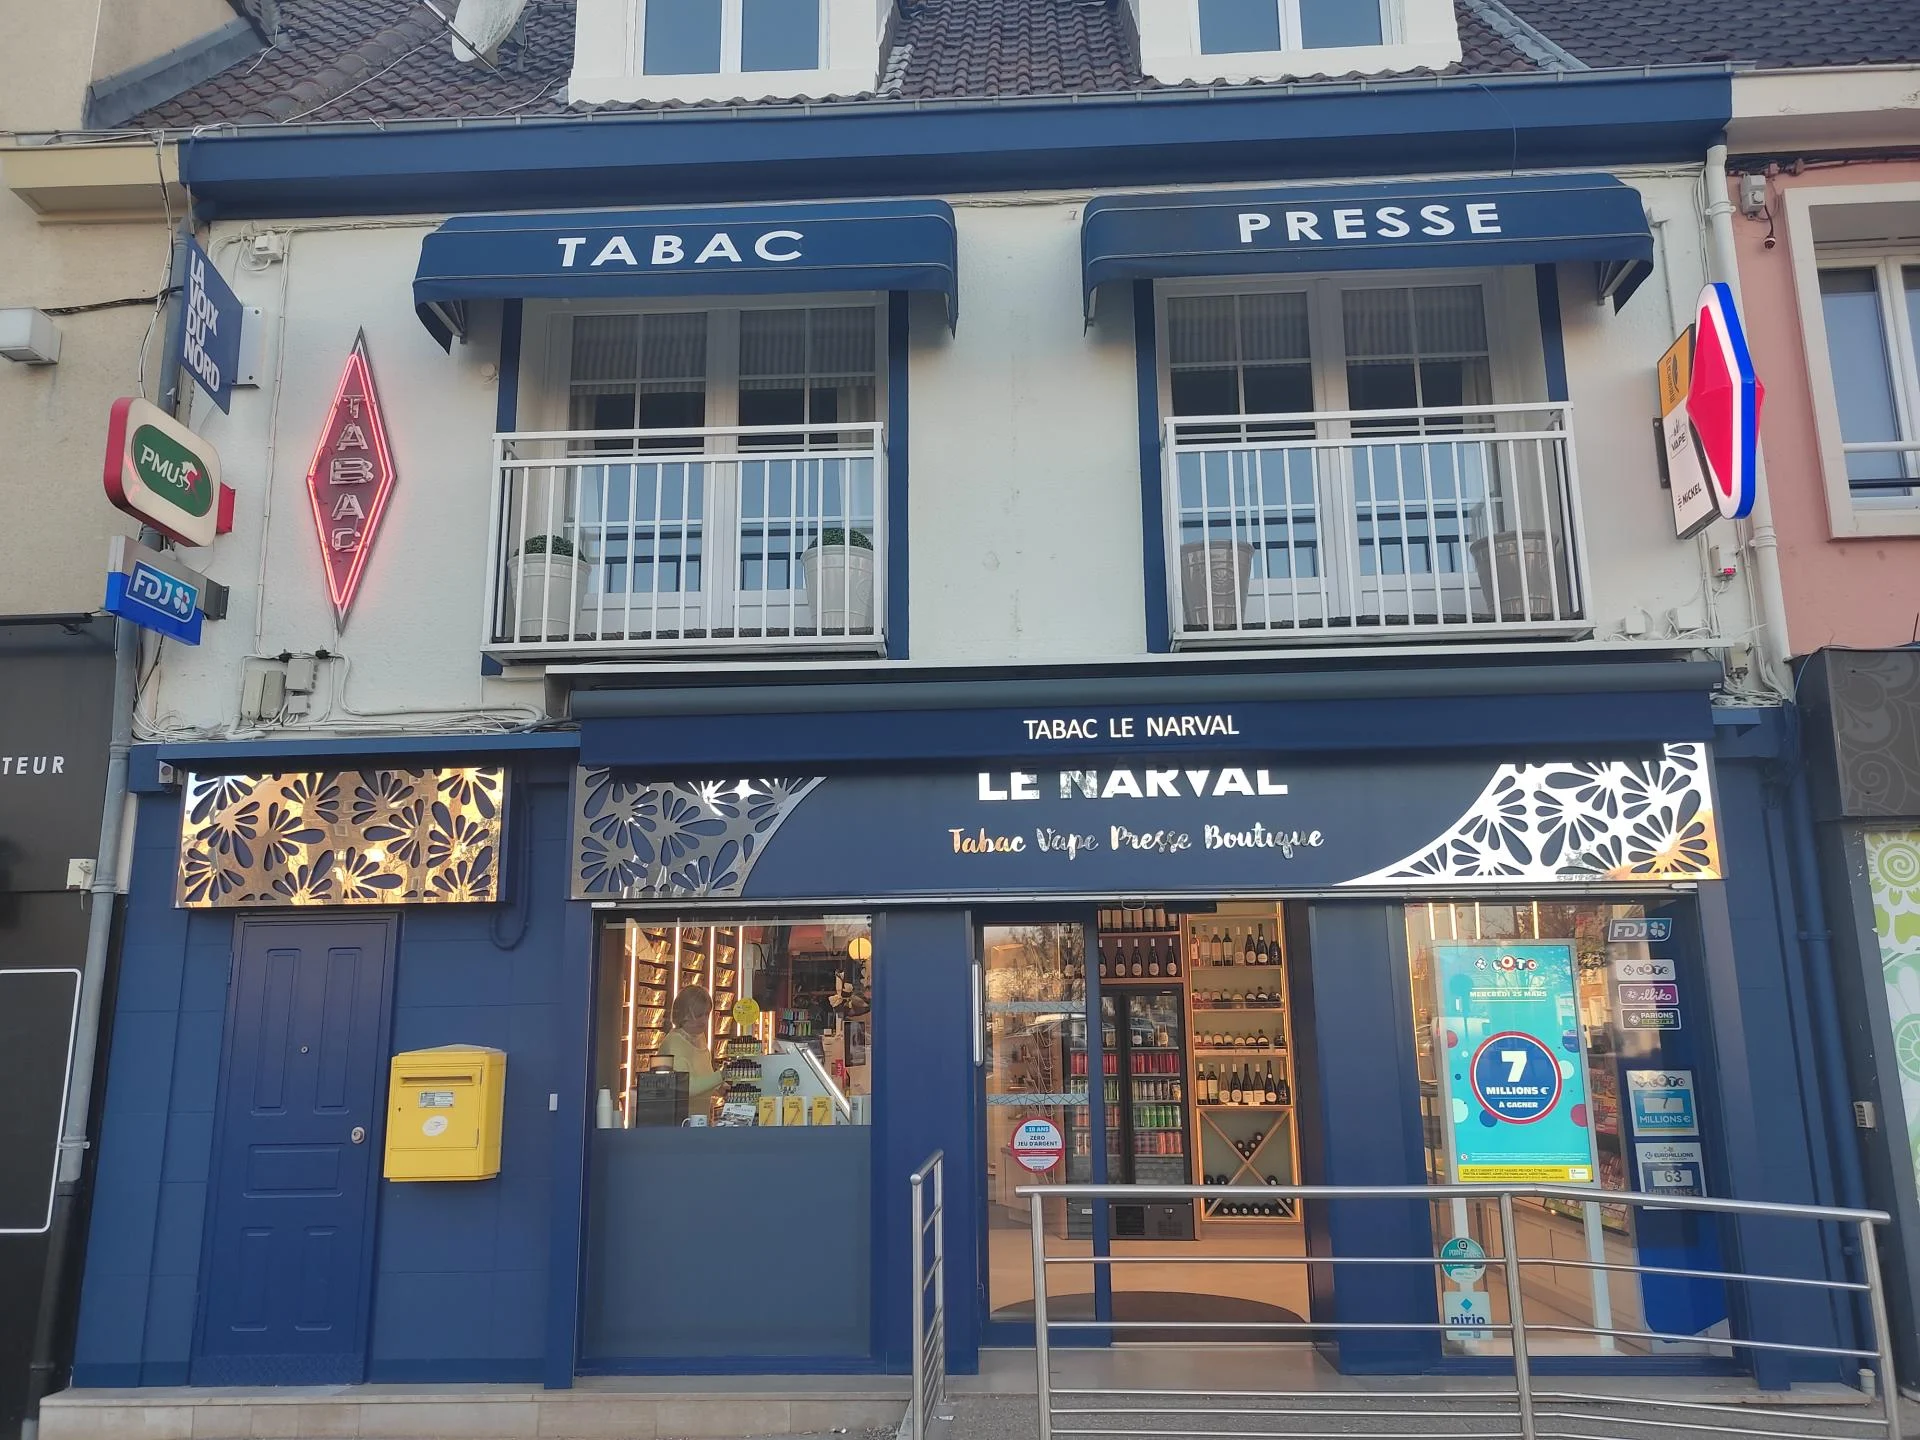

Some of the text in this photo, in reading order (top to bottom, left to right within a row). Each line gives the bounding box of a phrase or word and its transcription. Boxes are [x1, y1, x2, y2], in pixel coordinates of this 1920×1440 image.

[1238, 202, 1502, 243] PRESSE
[557, 230, 804, 267] TABAC
[190, 250, 205, 290] LA
[189, 276, 219, 336] VOIX
[186, 303, 206, 348] DU
[183, 330, 221, 393] NORD
[1671, 432, 1686, 451] VAPE
[140, 444, 179, 484] PMU
[329, 394, 377, 552] TABAC
[132, 568, 174, 606] FDJ
[1023, 714, 1239, 740] TABAC LE NARVAL
[2, 755, 65, 775] TEUR
[978, 767, 1289, 801] LE NARVAL
[948, 822, 1324, 860] Tabac Vape Presse Boutique
[1613, 922, 1648, 938] FDJ
[1491, 954, 1538, 972] LOTO
[1636, 963, 1669, 975] LOTO
[1469, 990, 1510, 998] MERCREDI
[1638, 987, 1672, 1001] illiko
[1501, 1050, 1528, 1083] 7
[1486, 1086, 1550, 1095] MILLIONS €
[1640, 1115, 1682, 1124] MILLIONS
[1664, 1171, 1682, 1183] 63
[1450, 1313, 1485, 1325] nirio
